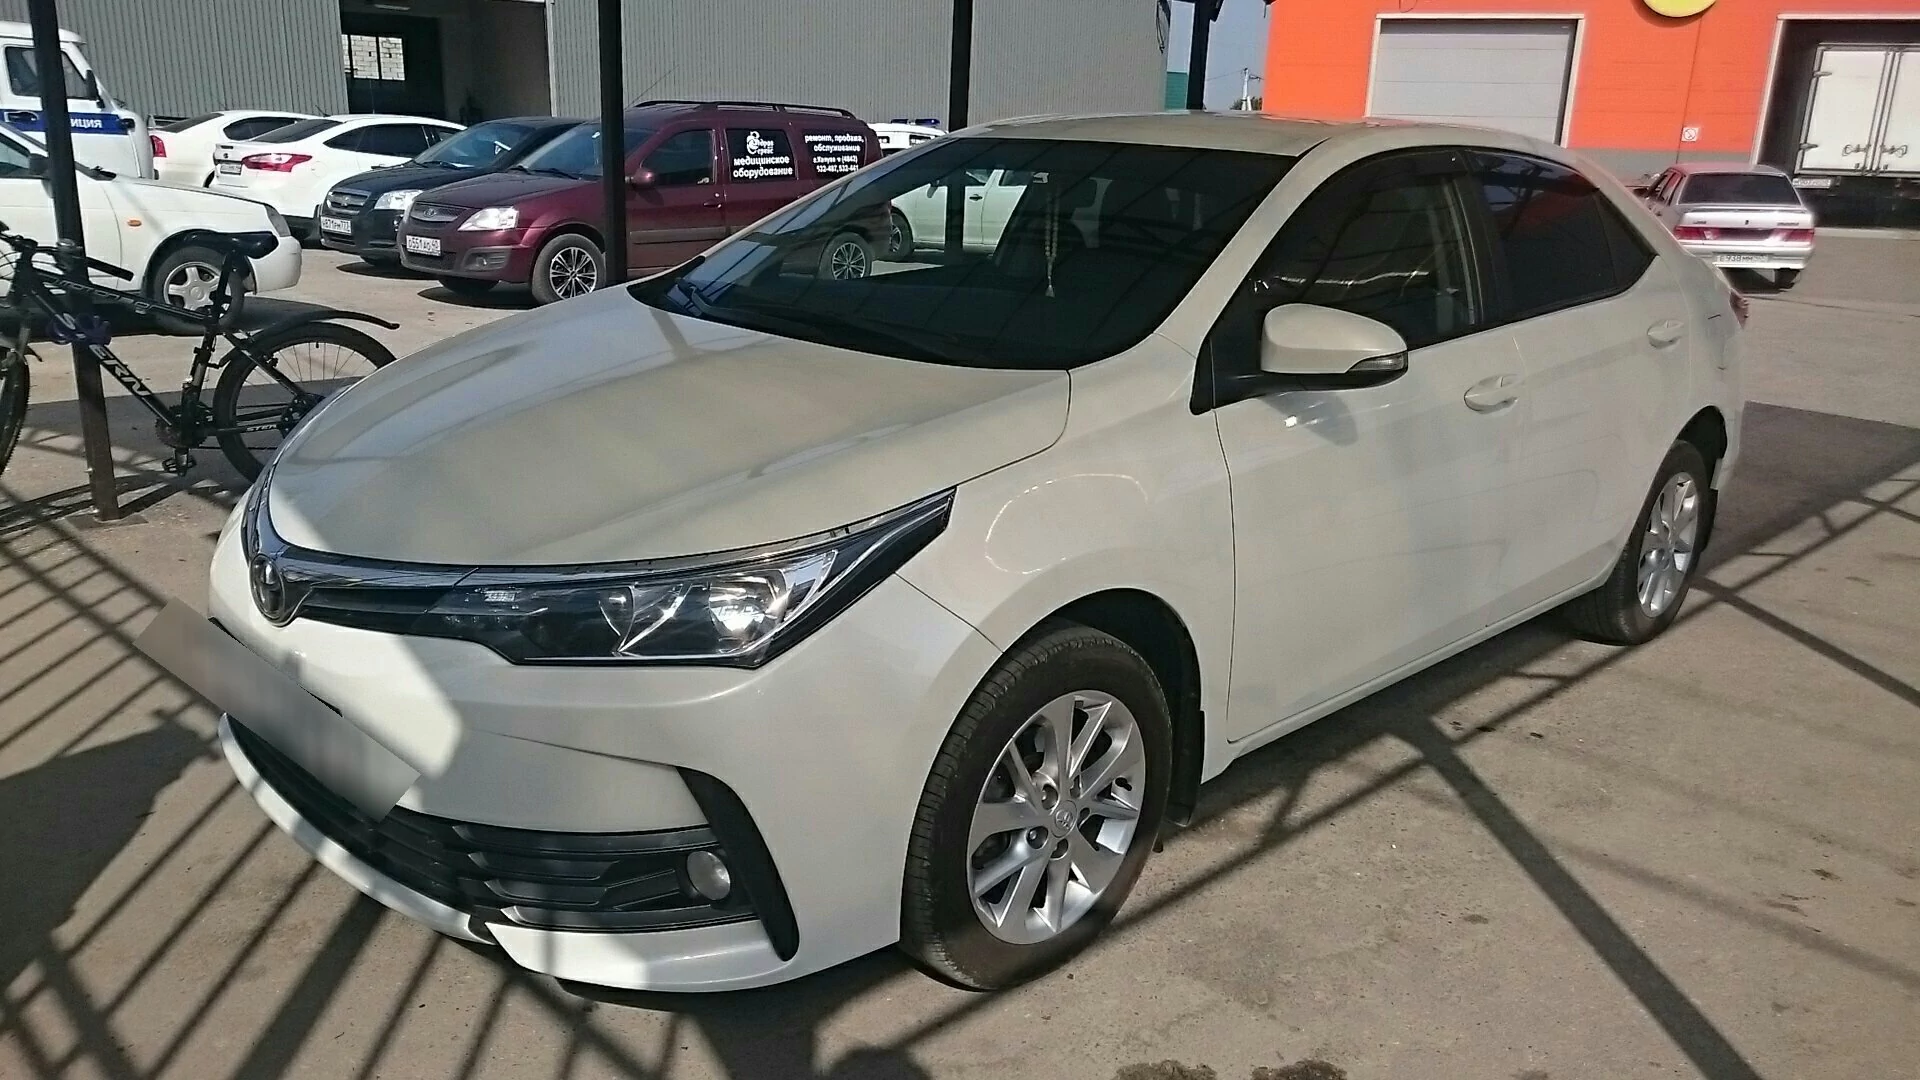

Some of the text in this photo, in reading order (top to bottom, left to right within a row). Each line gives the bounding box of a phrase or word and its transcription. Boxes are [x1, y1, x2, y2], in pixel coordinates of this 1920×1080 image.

[70, 118, 103, 128] ИЦИЯ
[813, 143, 861, 153] обслуживание
[733, 155, 790, 166] медицинское
[733, 167, 793, 179] оборудование
[55, 312, 151, 396] SERN
